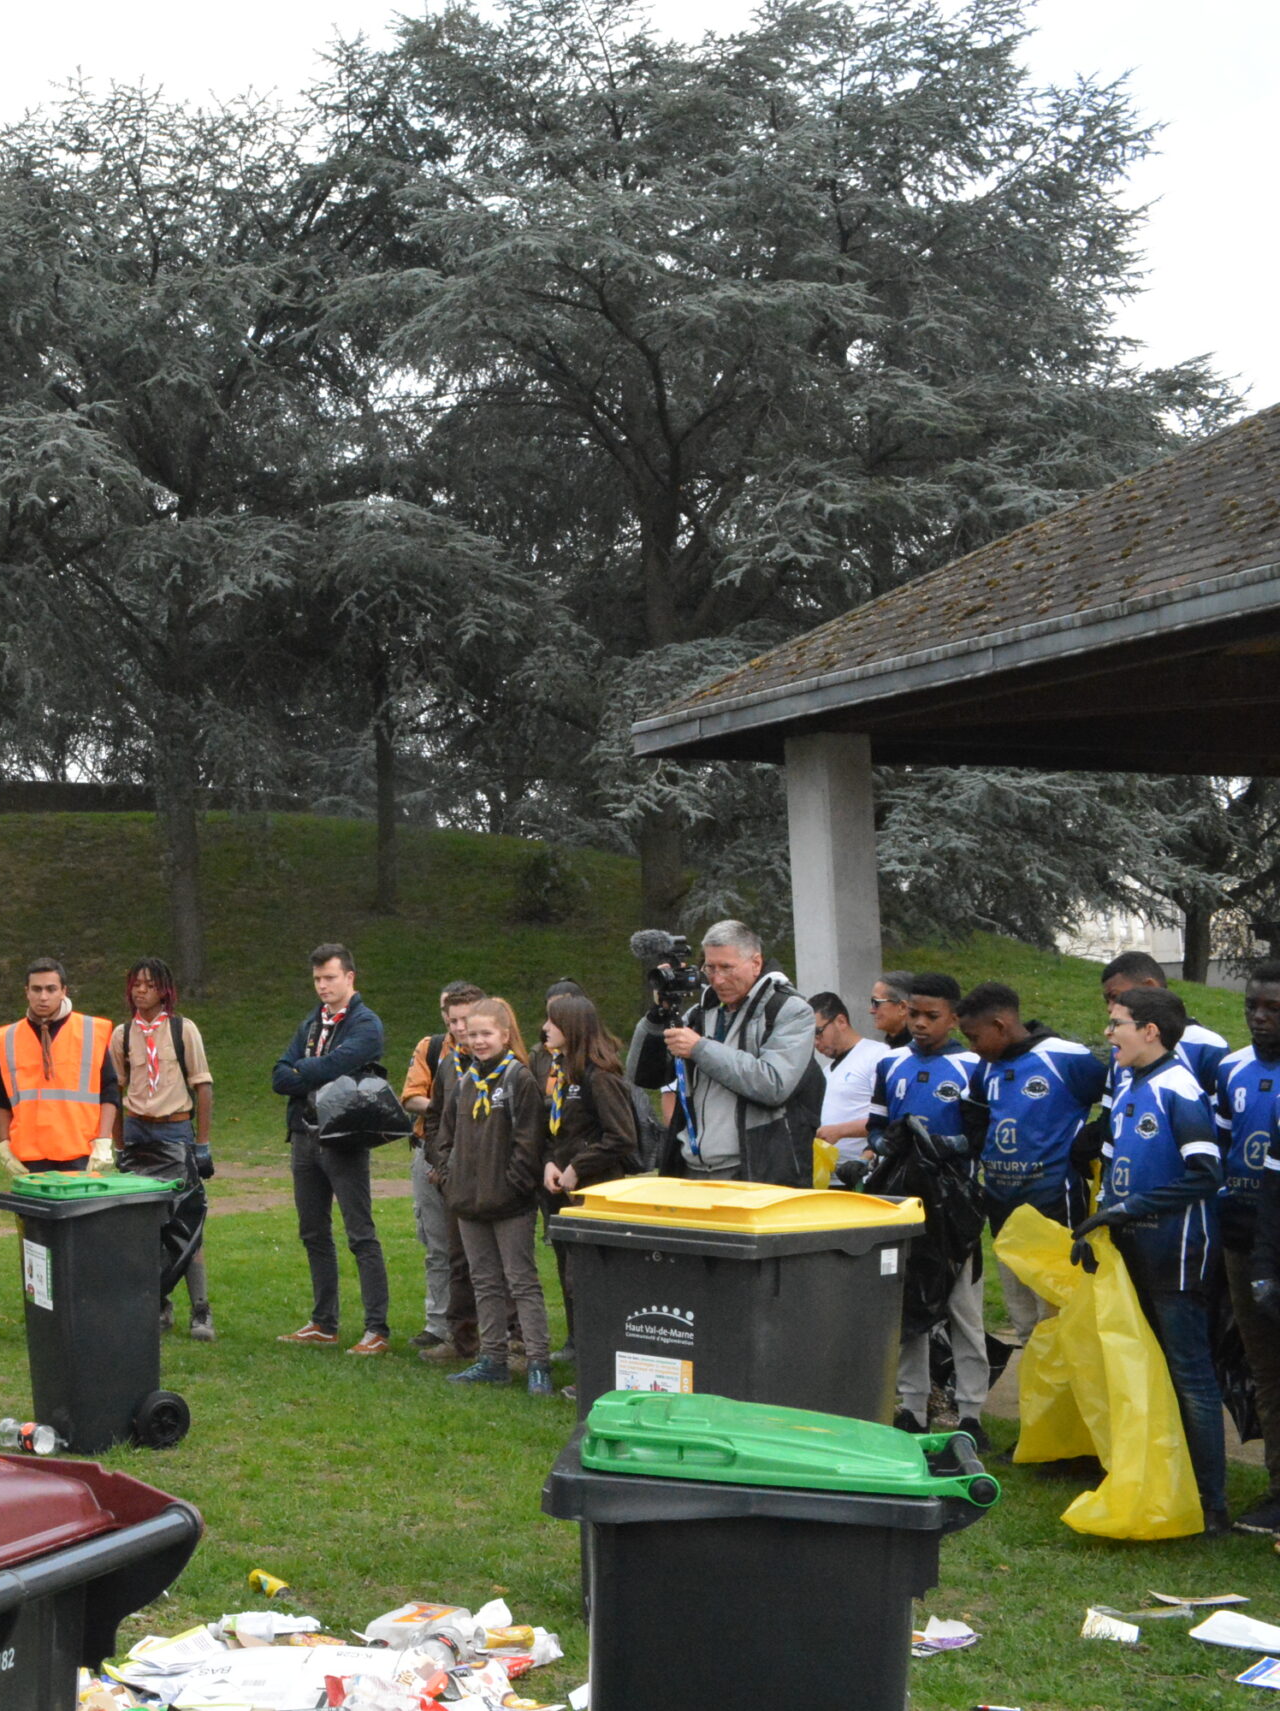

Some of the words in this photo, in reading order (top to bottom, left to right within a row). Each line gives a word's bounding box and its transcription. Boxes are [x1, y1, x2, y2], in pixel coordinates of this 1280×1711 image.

[895, 1078, 907, 1100] 4
[1234, 1087, 1247, 1113] 8
[625, 1322, 644, 1333] Haut
[645, 1324, 694, 1340] Val-de-Marne
